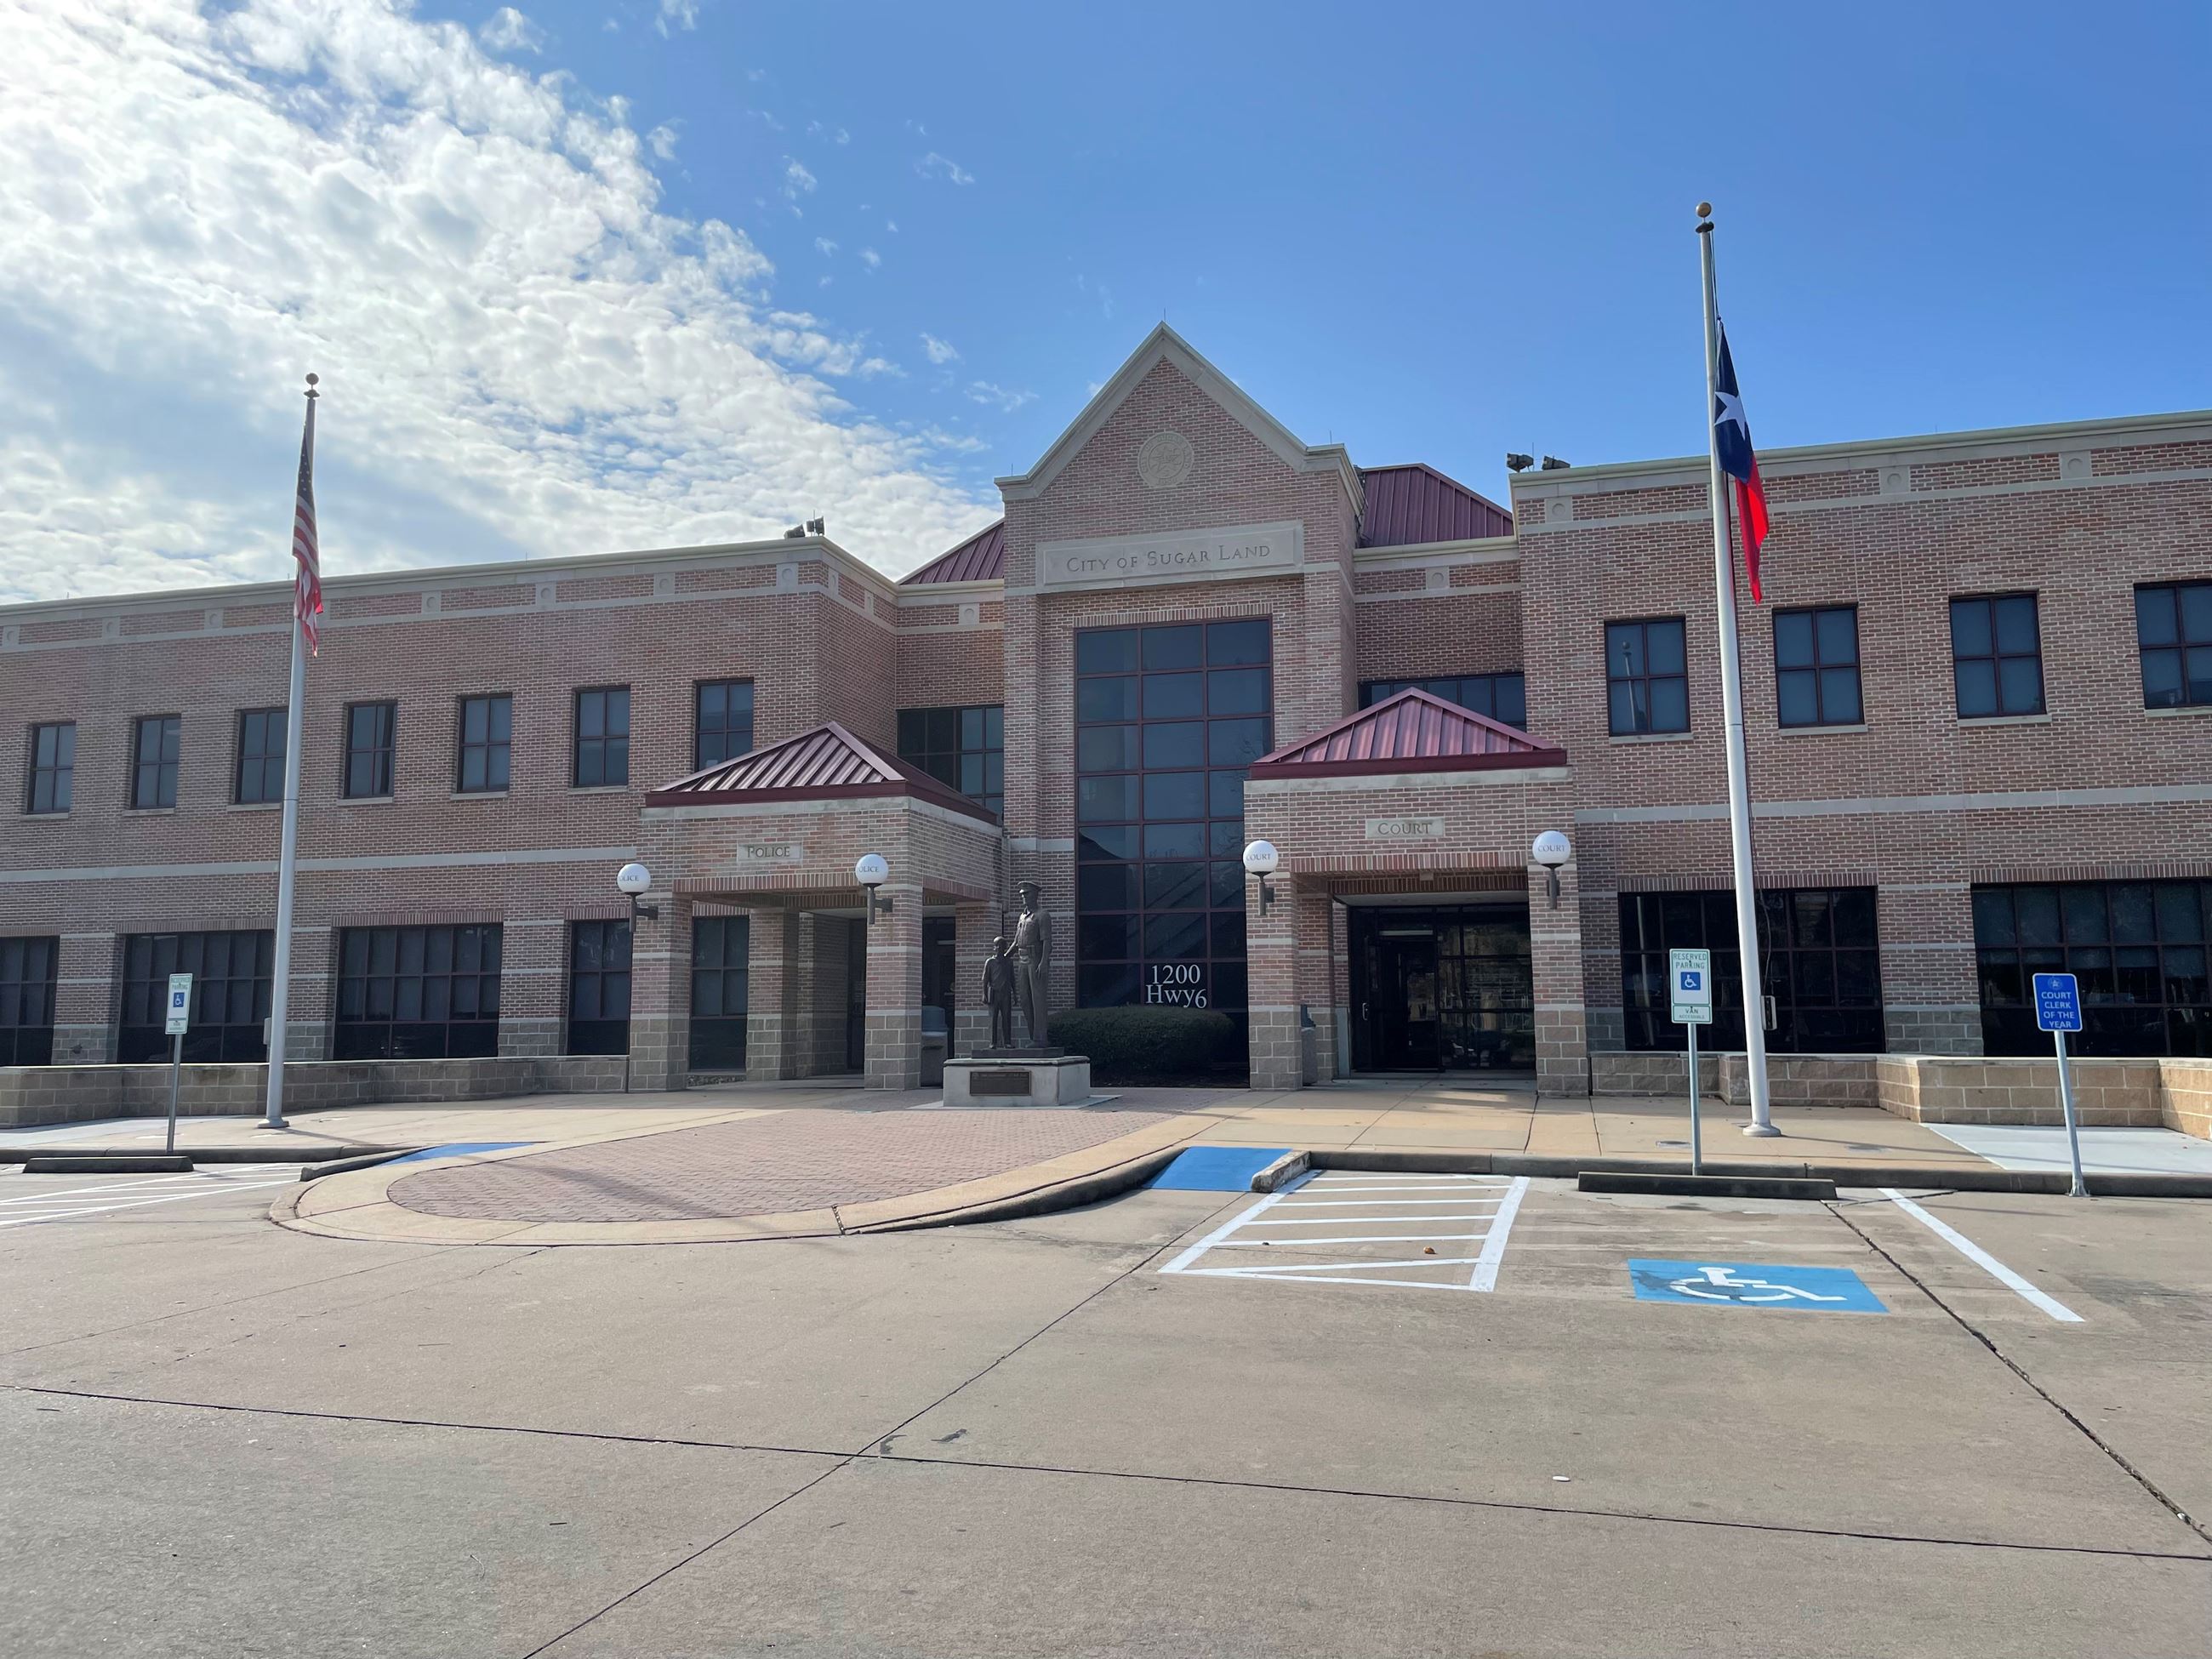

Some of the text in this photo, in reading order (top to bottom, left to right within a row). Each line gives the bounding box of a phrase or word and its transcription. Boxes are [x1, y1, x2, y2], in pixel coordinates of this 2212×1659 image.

[1067, 544, 1270, 573] CITY OF SUGAR LAND
[1377, 822, 1433, 835] COURT
[747, 846, 790, 858] POLICE
[1673, 952, 1707, 961] RESERVED
[1152, 964, 1200, 984] 1200
[2043, 1011, 2075, 1019] OF THE
[2049, 1020, 2072, 1029] YEAR
